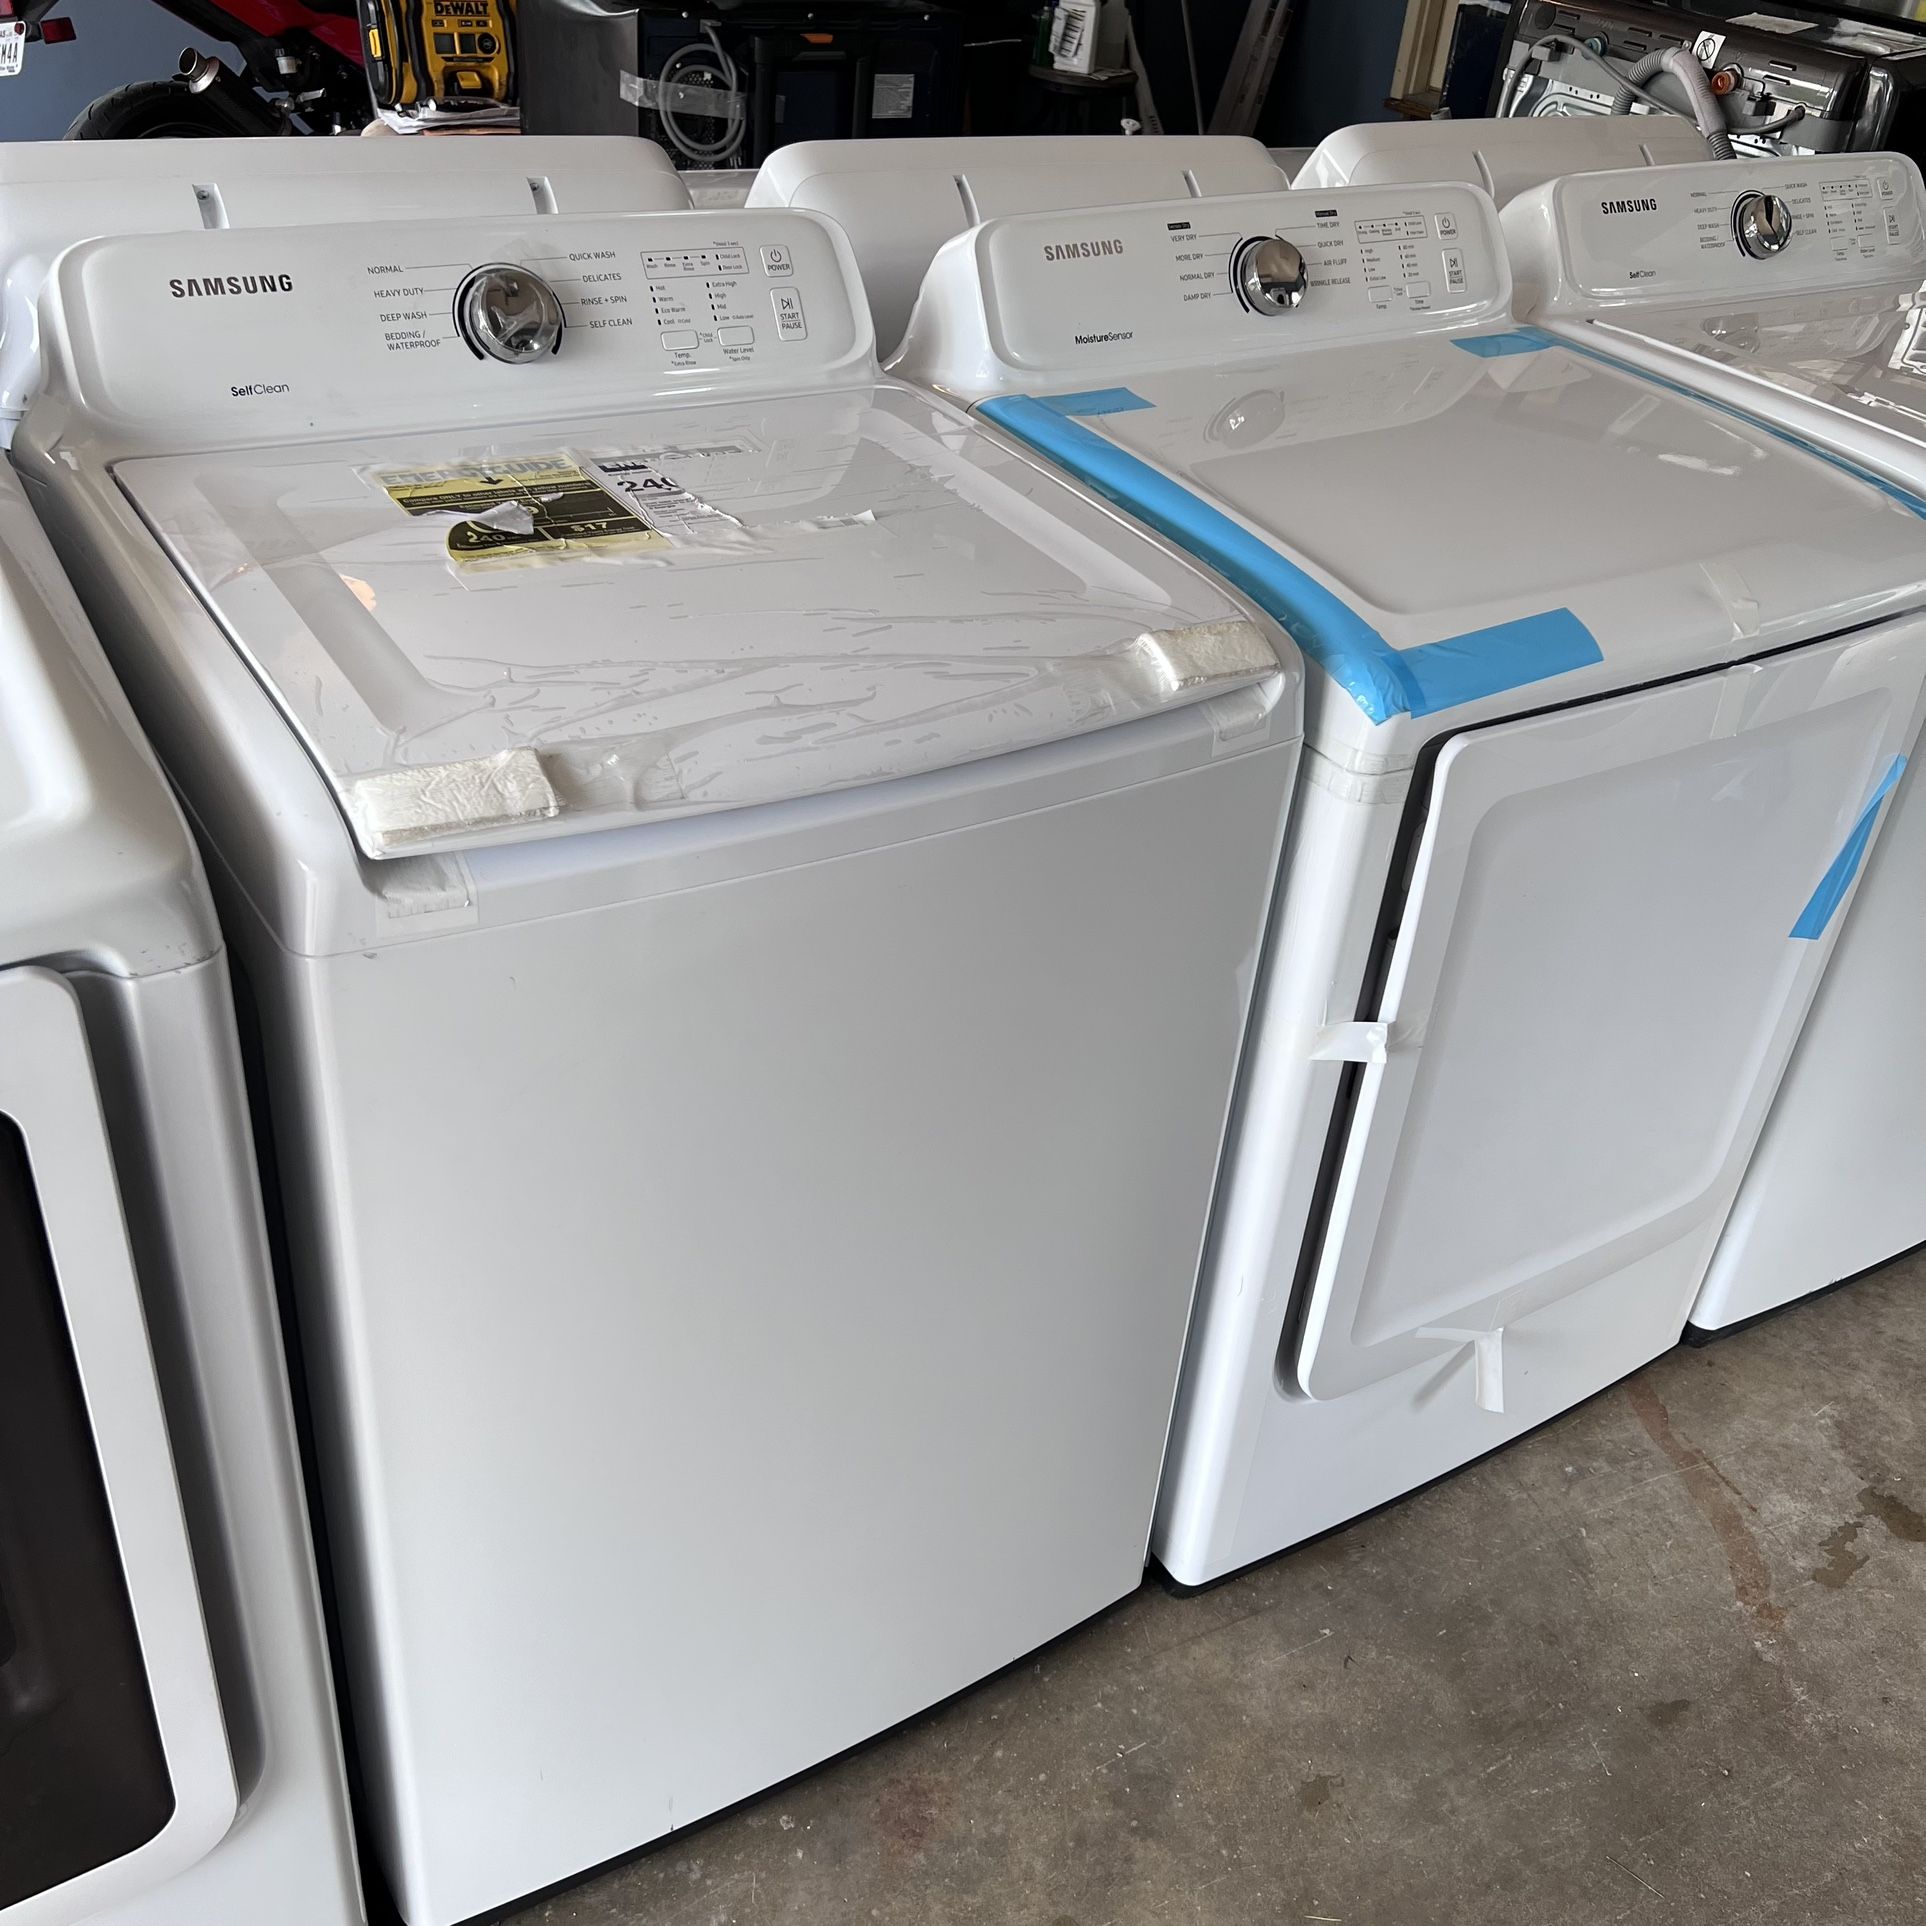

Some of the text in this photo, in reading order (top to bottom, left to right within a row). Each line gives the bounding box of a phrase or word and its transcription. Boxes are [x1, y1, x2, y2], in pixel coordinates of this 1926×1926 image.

[1601, 198, 1657, 214] SAMSUNG
[1440, 228, 1456, 236] POWER
[569, 250, 616, 261] QUICK WASH
[1044, 239, 1124, 261] SAMSUNG
[367, 265, 404, 275] NORMAL
[767, 263, 791, 272] POWER
[582, 272, 622, 283] DELICATES
[1180, 271, 1215, 281] NORMAL DRY
[1629, 270, 1656, 279] SelfClean
[169, 274, 293, 298] SAMSUNG
[374, 287, 424, 298] HEAVY DUTY
[1200, 292, 1211, 300] DRY
[581, 297, 603, 307] RINSE
[609, 295, 628, 304] SPIN
[380, 310, 427, 322] DEEP WASH
[780, 311, 799, 320] START
[589, 317, 633, 329] SELF CLEAN
[782, 321, 802, 330] PAUSE
[384, 330, 421, 341] BEDDING
[1075, 331, 1133, 344] MoistureSensor
[386, 338, 441, 351] WATERPROOF
[723, 346, 755, 355] Water Level
[231, 384, 290, 397] SelfClean
[571, 522, 608, 533] $17
[467, 531, 507, 542] 240
